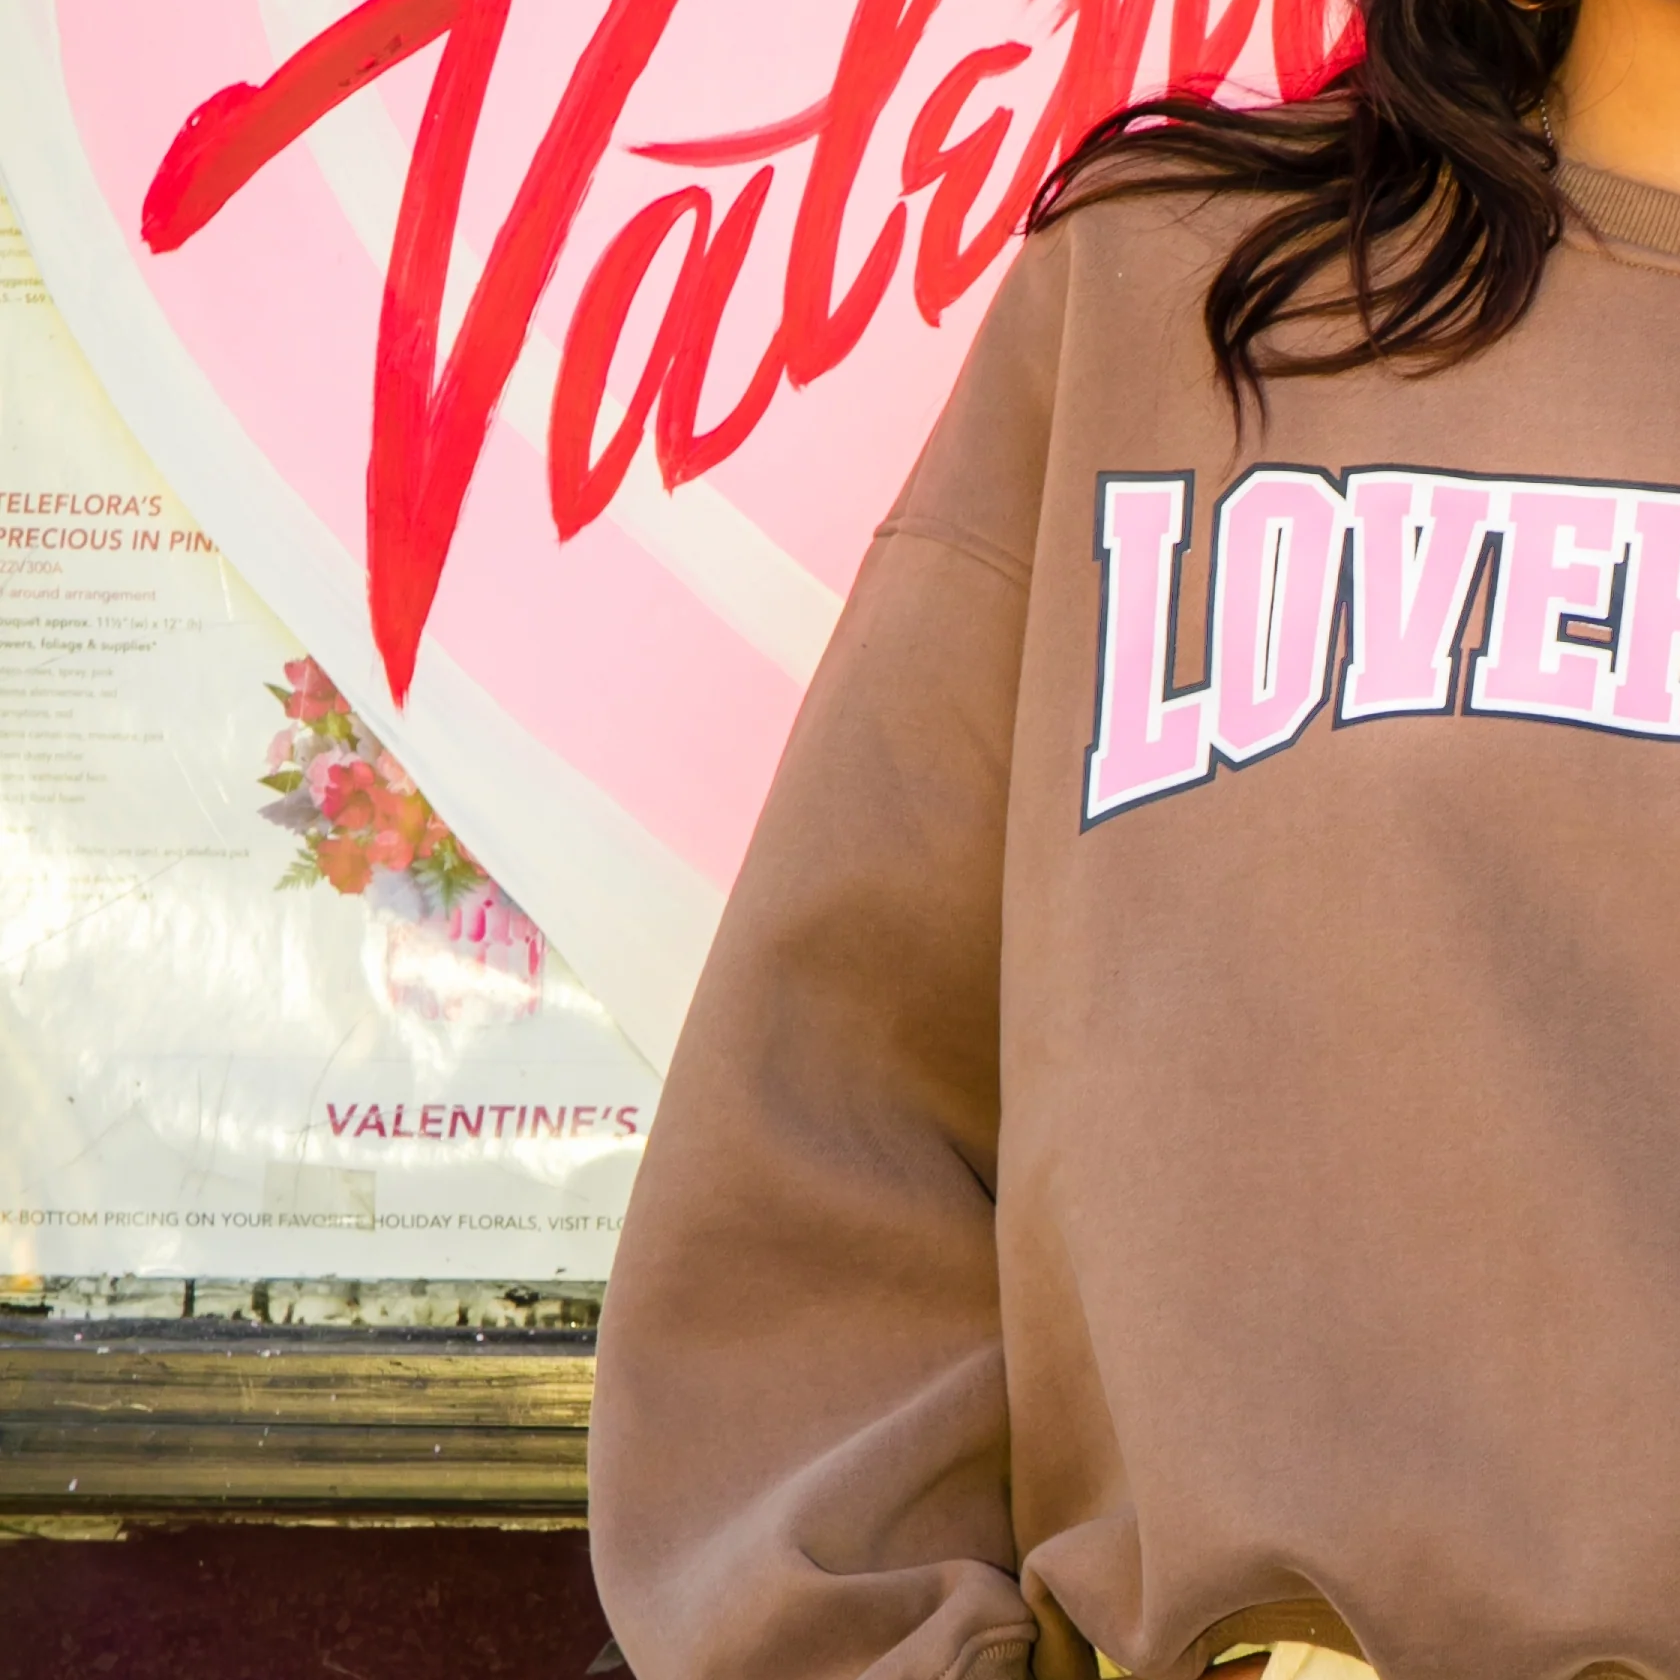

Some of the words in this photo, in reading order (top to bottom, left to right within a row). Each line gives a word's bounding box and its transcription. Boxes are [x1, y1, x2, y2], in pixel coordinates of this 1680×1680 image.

[132, 529, 160, 552] IN
[169, 530, 220, 553] PIN
[64, 588, 157, 605] arrangement
[327, 1103, 640, 1139] VALENTINE'S
[104, 1210, 179, 1227] PRICING
[185, 1211, 215, 1227] ON
[221, 1211, 273, 1228] YOUR
[278, 1212, 374, 1229] FAVORITE
[374, 1213, 453, 1230] HOLIDAY
[458, 1214, 542, 1232] FLORALS,
[547, 1215, 591, 1231] VISIT
